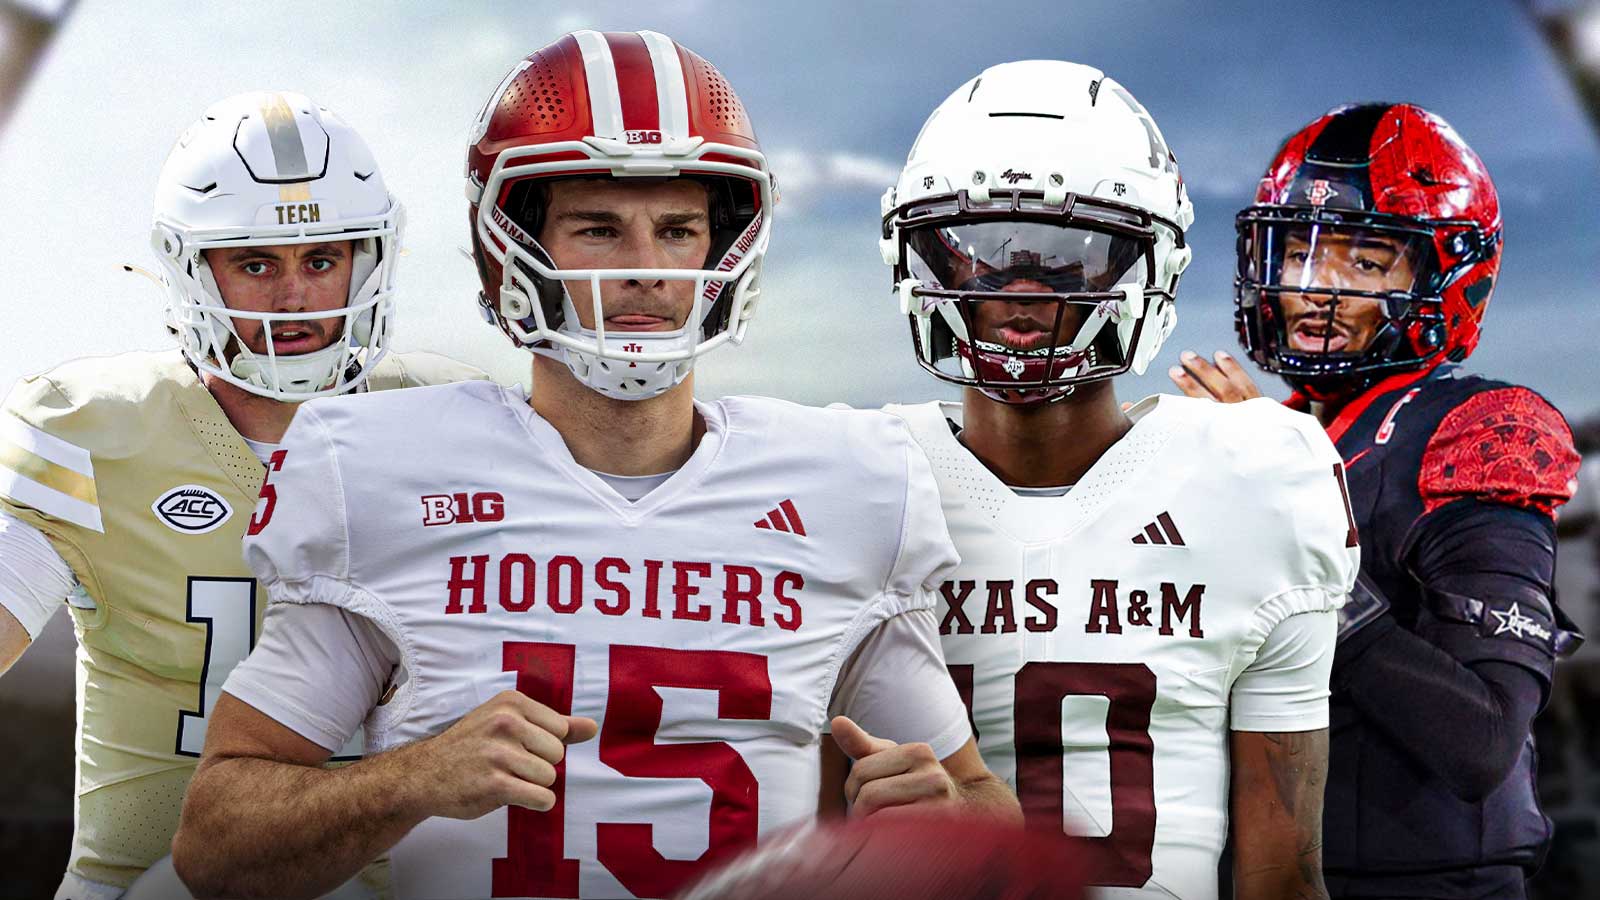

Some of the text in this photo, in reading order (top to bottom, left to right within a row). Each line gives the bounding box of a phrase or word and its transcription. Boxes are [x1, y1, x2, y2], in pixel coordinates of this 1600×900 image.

[275, 203, 321, 224] TECH
[168, 499, 217, 514] ACC
[445, 553, 805, 631] HOOSIERS
[1085, 578, 1206, 638] A&M
[491, 641, 773, 899] 15
